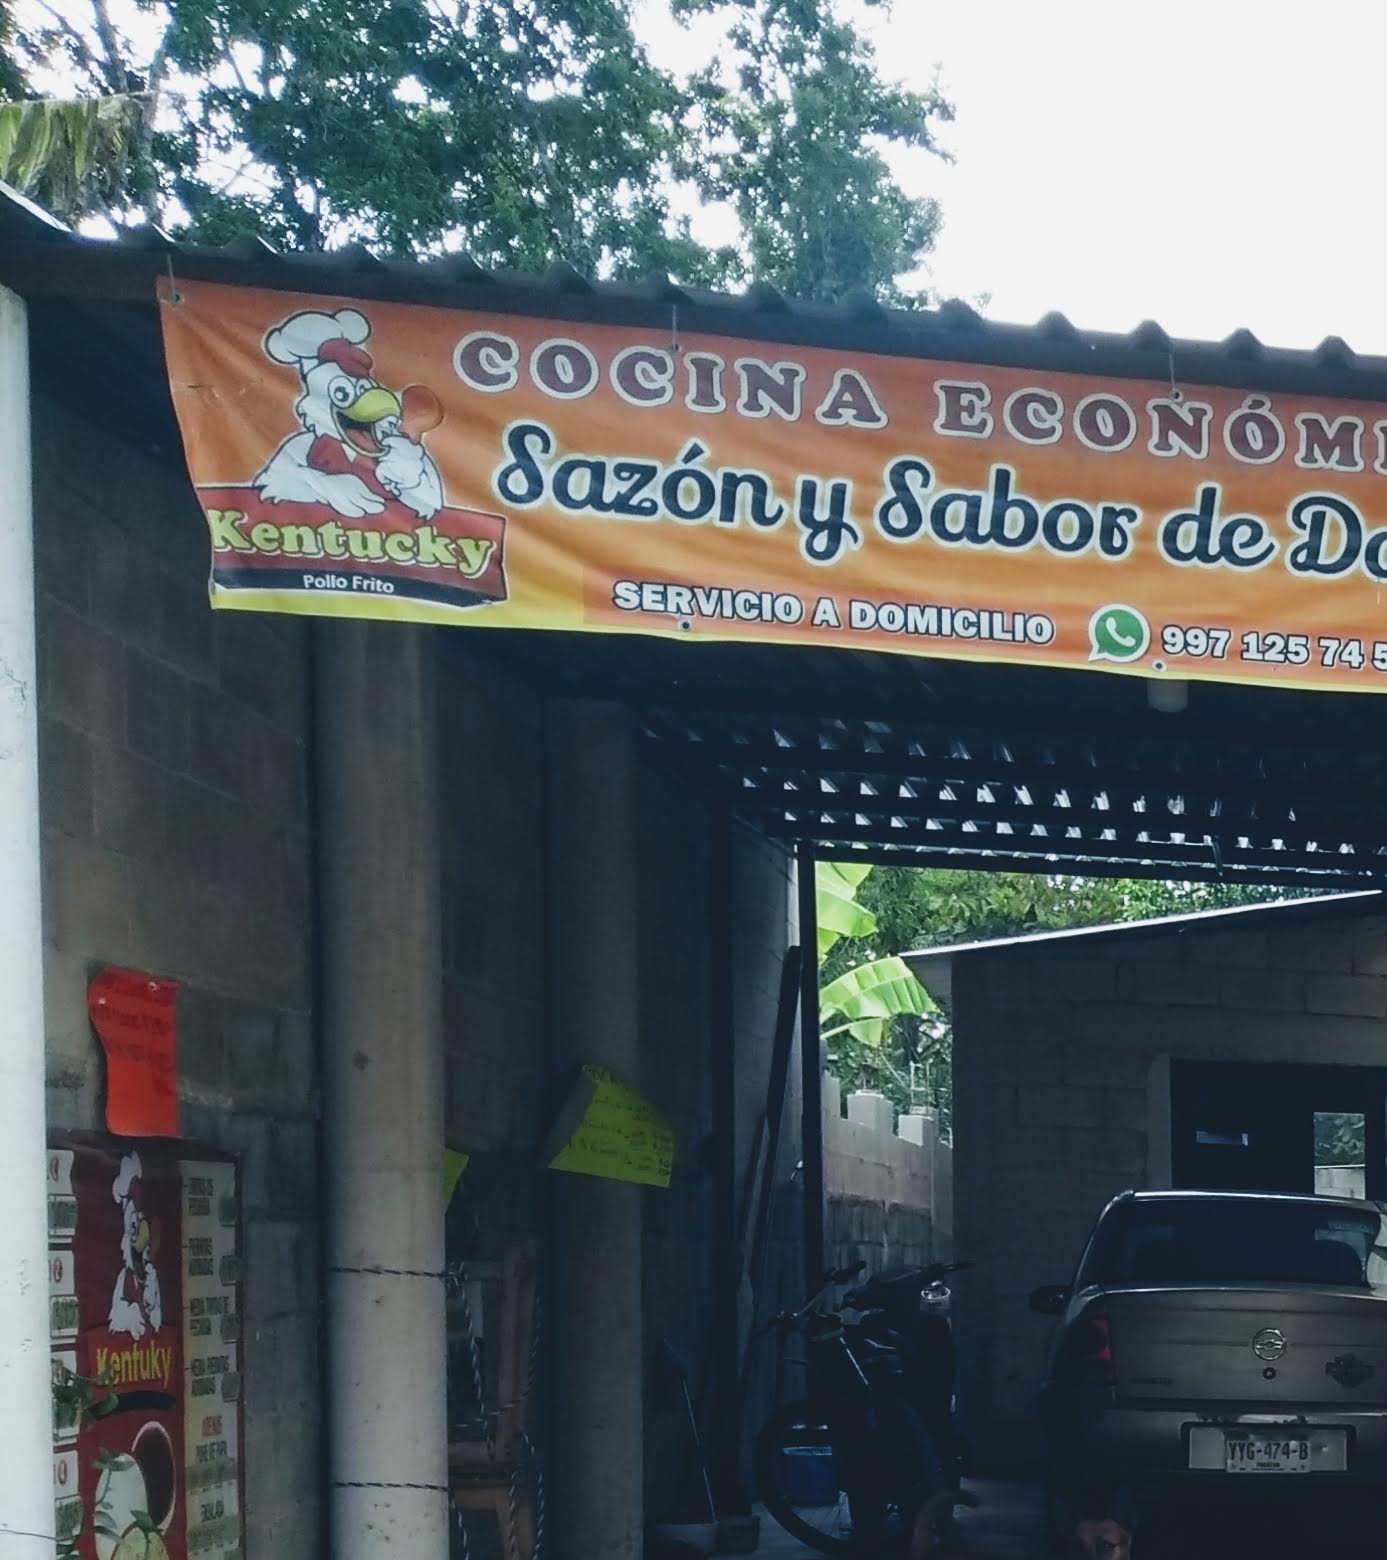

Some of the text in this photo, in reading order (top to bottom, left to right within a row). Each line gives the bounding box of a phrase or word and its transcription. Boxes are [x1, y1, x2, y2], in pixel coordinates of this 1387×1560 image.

[453, 331, 889, 429] COCINA
[496, 422, 785, 531] Sazón
[798, 476, 862, 564] y
[875, 457, 1140, 559] Sabor
[1158, 485, 1276, 571] de
[205, 508, 497, 580] Kentucky
[302, 573, 396, 594] Pollo Frito
[612, 579, 1056, 646] SERVICIO A DOMICILIO
[1161, 624, 1233, 658] 997
[1240, 630, 1311, 666] 125
[1316, 635, 1365, 670] 74
[1228, 1441, 1309, 1461] YYG-474-B
